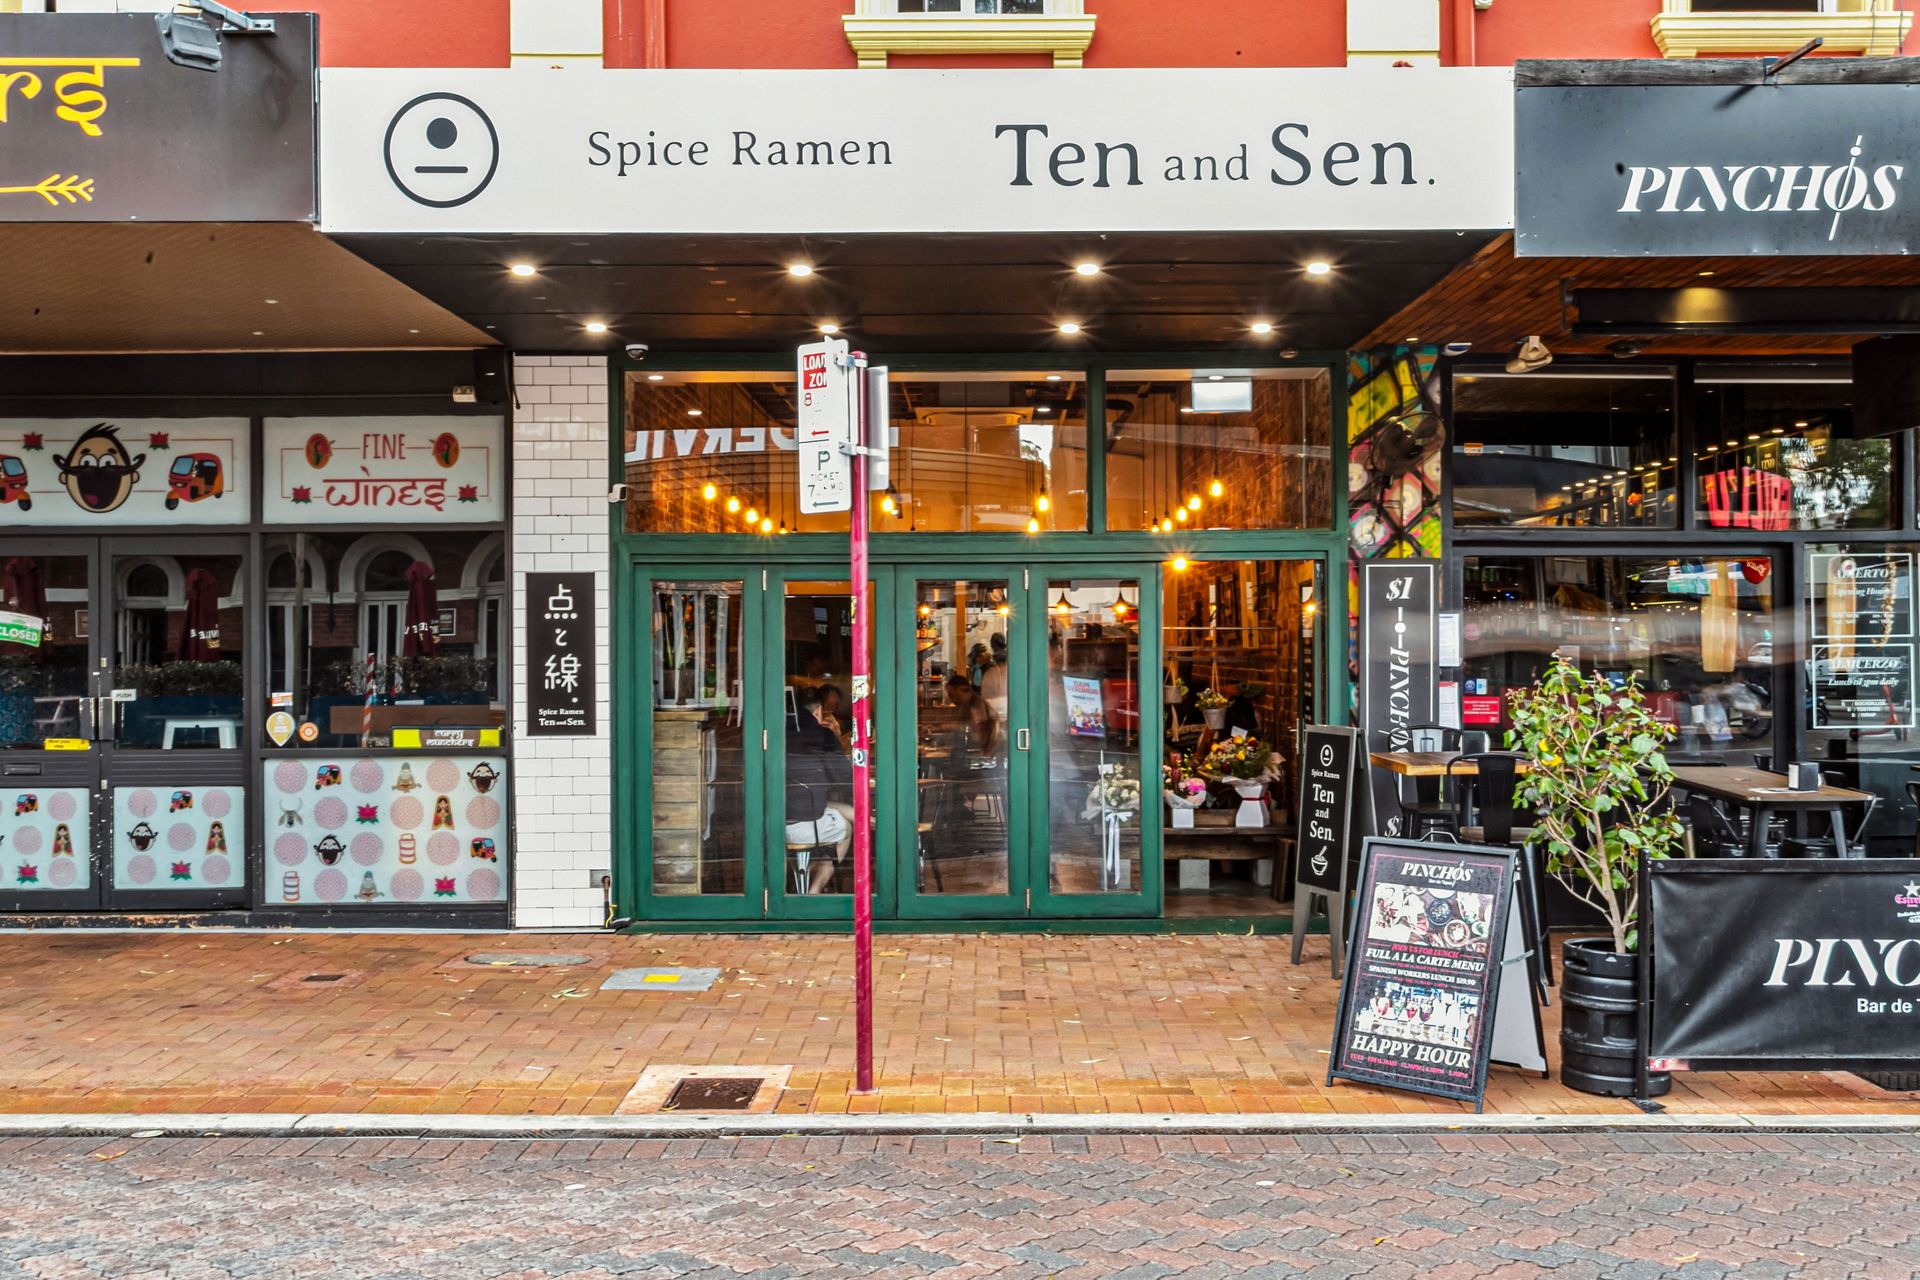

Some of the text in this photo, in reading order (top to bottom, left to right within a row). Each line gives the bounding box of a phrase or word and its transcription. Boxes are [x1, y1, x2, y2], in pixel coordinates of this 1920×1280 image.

[588, 122, 1435, 187] Spice Ramen Ten and Sen.
[1616, 148, 1904, 228] PINCHOS
[804, 392, 812, 407] 8
[362, 433, 406, 460] FINE
[818, 450, 831, 471] P
[1386, 576, 1414, 602] $1
[538, 708, 558, 717] Spice
[538, 717, 556, 726] Ten
[1311, 769, 1340, 779] Spice Ramen
[1312, 783, 1335, 804] Ten
[1315, 808, 1330, 819] and
[1309, 820, 1336, 842] Sen.
[1401, 861, 1474, 884] PINCHOS
[1366, 948, 1391, 960] FULL
[1391, 951, 1400, 961] A
[1401, 952, 1415, 963] LA
[1416, 954, 1451, 968] CARTE
[1451, 959, 1485, 972] MENU
[1391, 943, 1460, 958] JOIN US FOR LUNCH
[1763, 939, 1920, 986] PINC
[1368, 965, 1397, 975] SPANISH
[1397, 968, 1430, 980] WORKERS
[1431, 973, 1455, 983] LUNCH
[1856, 998, 1887, 1013] Bar
[1890, 998, 1912, 1013] de
[1350, 1034, 1471, 1068] HAPPY HOUR
